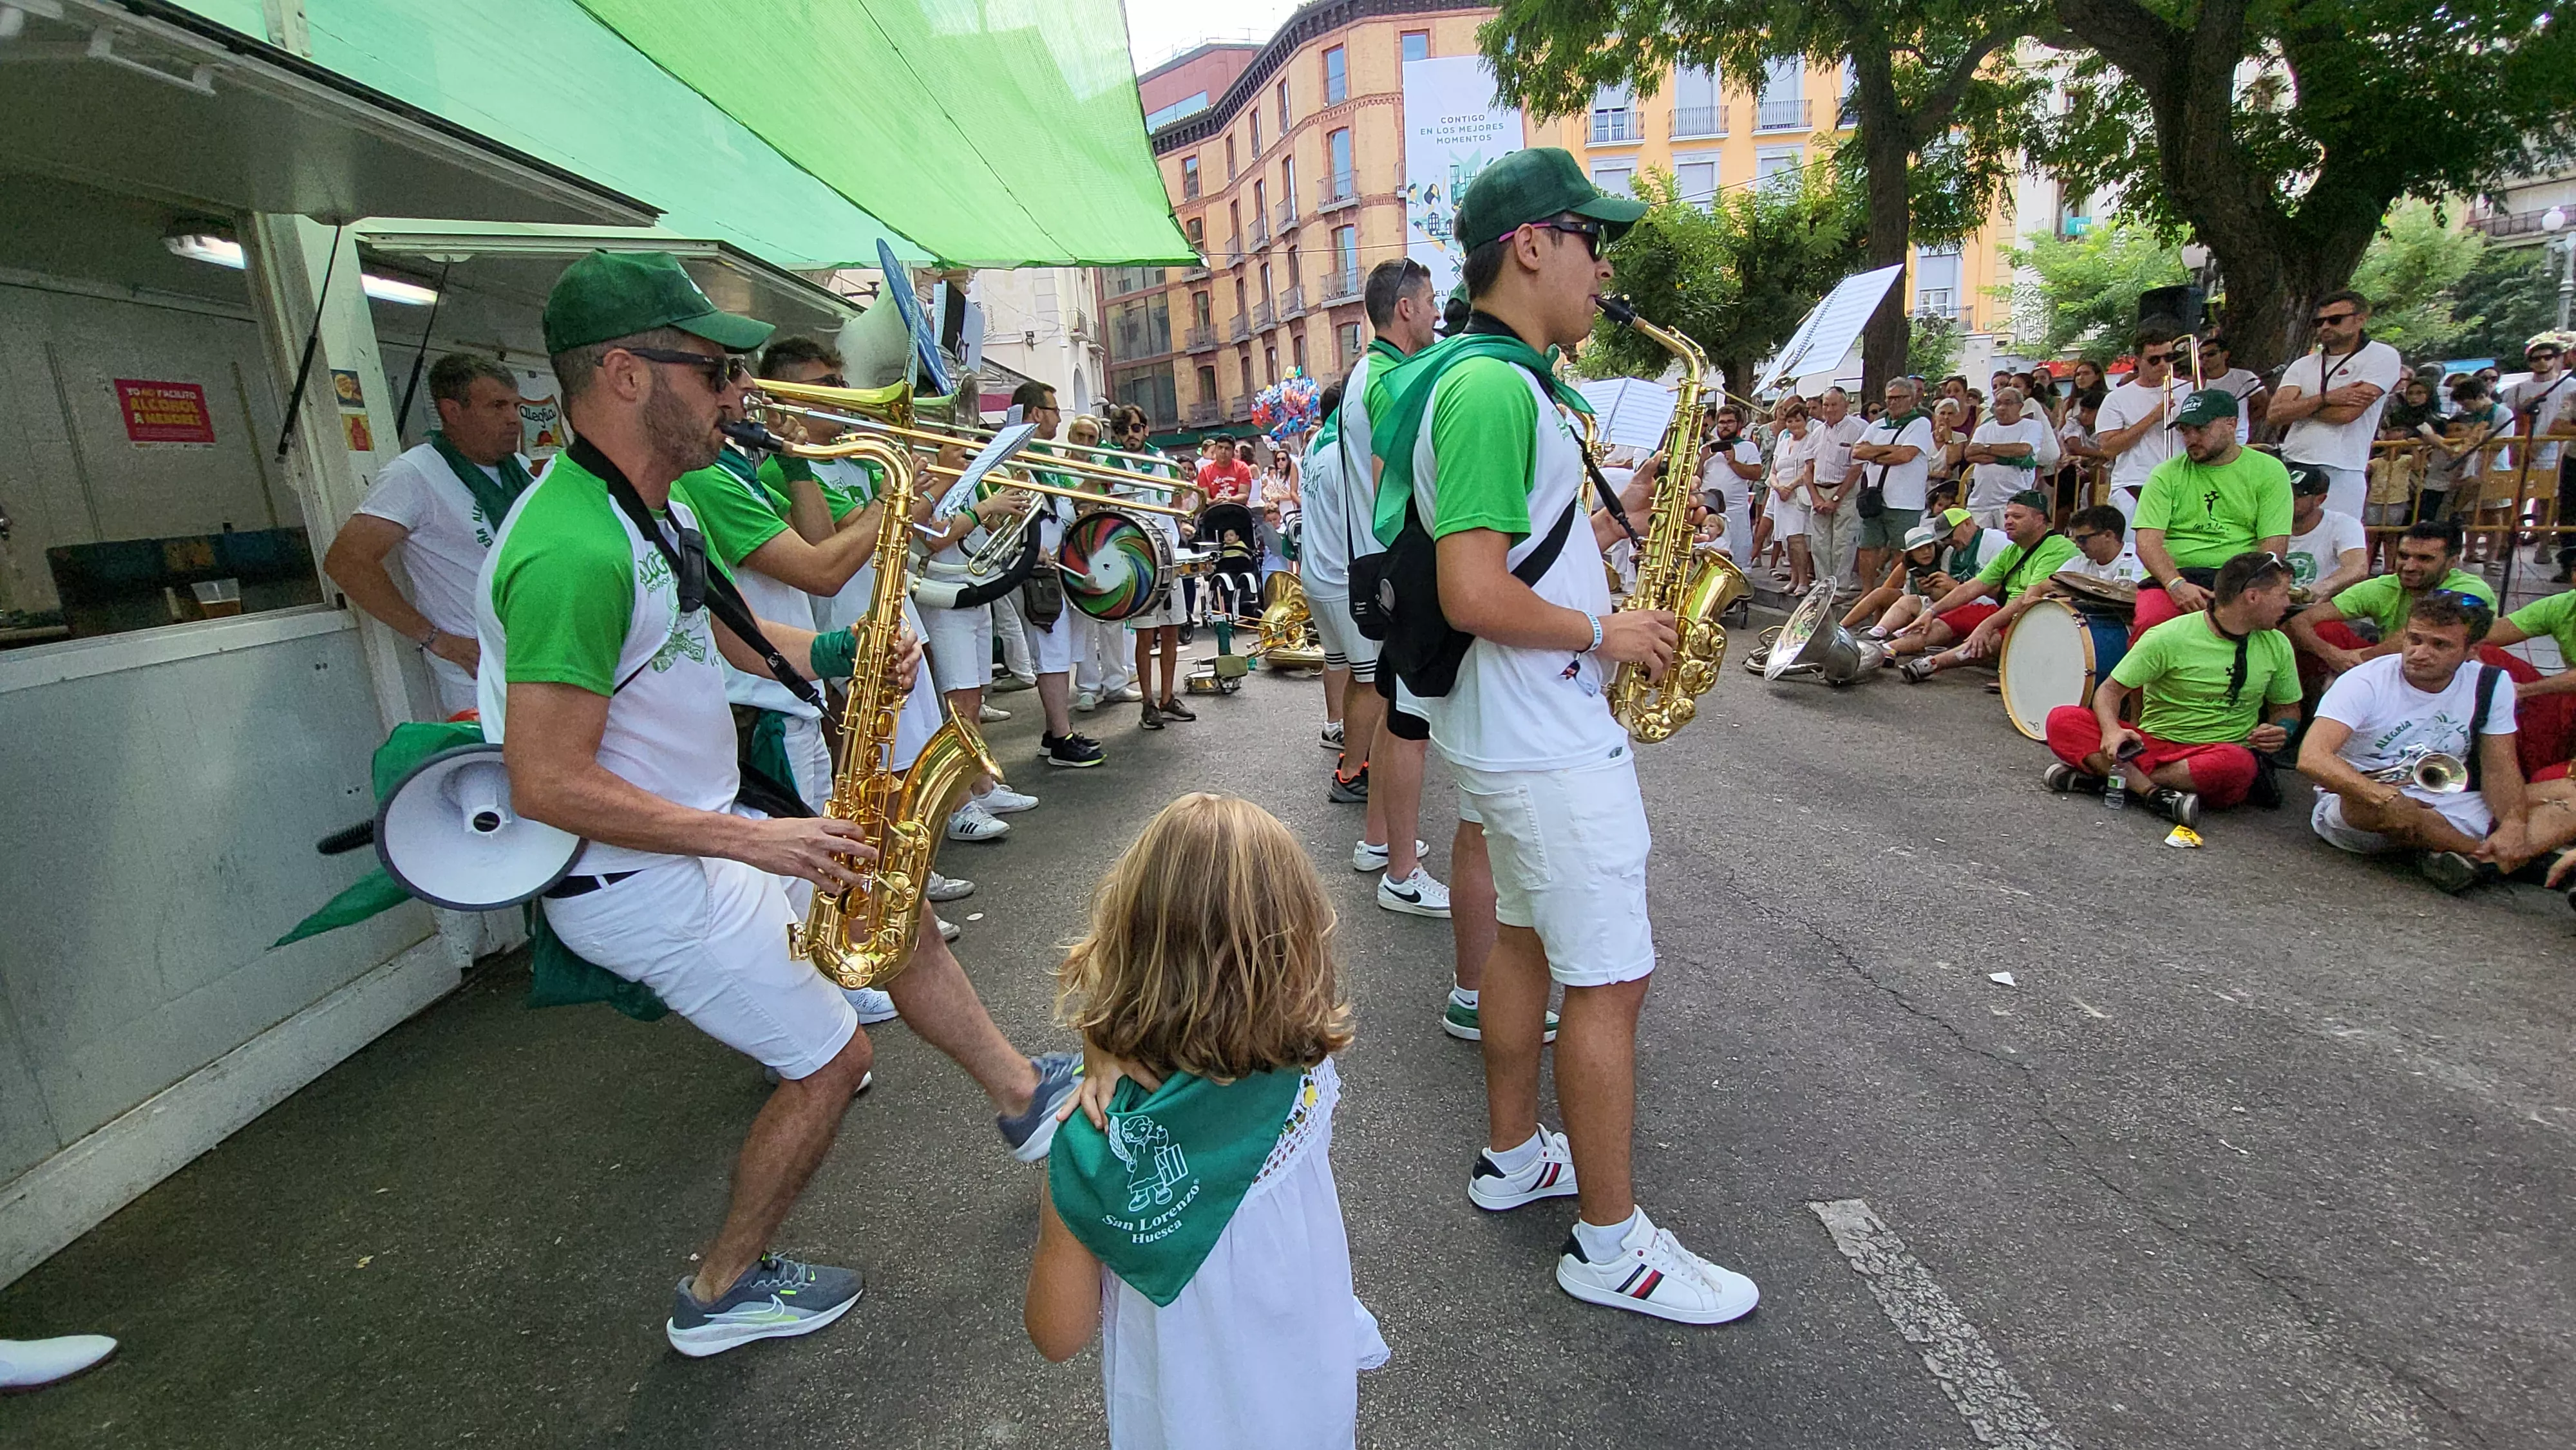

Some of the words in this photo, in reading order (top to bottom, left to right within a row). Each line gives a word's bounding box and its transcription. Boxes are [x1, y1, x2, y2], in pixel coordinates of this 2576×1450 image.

[1440, 114, 1485, 124] CONTIGO
[1459, 122, 1504, 133] MEJORES
[1437, 134, 1492, 144] MOMENTOS
[131, 397, 199, 413] ALCOHOL
[134, 412, 144, 424] A
[146, 413, 201, 426] MENORES
[1102, 1214, 1134, 1231] San
[1139, 1185, 1200, 1231] Lorenzo
[1132, 1219, 1182, 1243] Huesca
